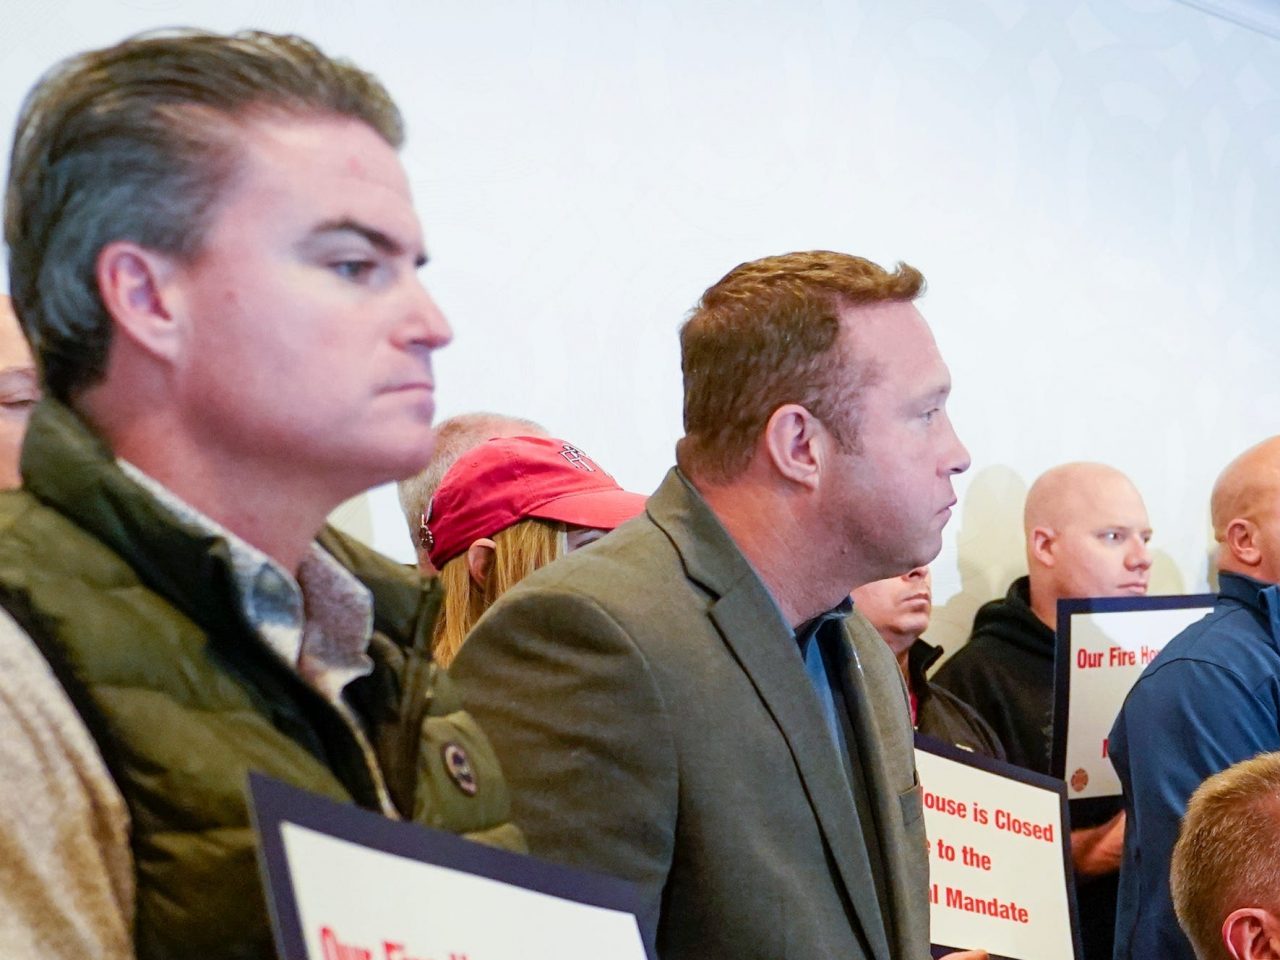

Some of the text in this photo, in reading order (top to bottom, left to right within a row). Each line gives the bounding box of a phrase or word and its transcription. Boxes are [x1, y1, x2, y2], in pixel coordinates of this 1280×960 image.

[1077, 648, 1104, 669] Our
[1109, 646, 1136, 667] Fire
[920, 786, 1054, 843] ouse is Closed
[937, 838, 956, 862] to
[961, 846, 992, 871] the
[945, 887, 1029, 924] Mandate
